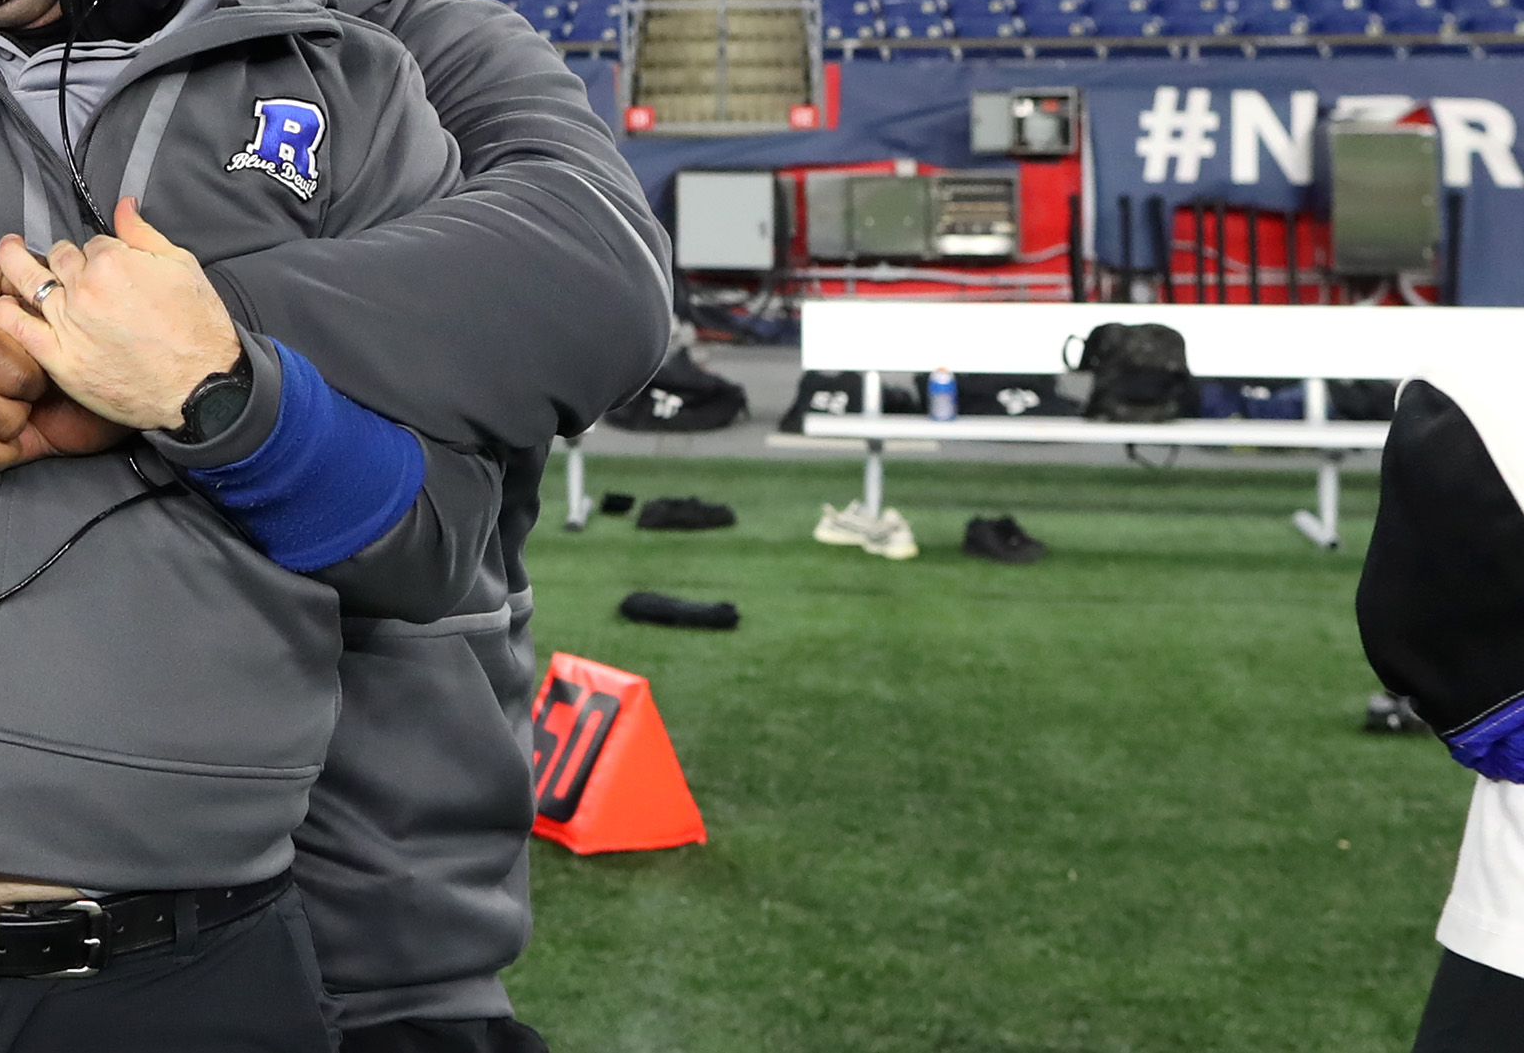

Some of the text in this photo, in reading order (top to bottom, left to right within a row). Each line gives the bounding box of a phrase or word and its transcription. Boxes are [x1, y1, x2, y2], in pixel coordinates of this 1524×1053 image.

[226, 152, 277, 174] Blue
[245, 98, 326, 180] R
[1135, 85, 1524, 189] #NR
